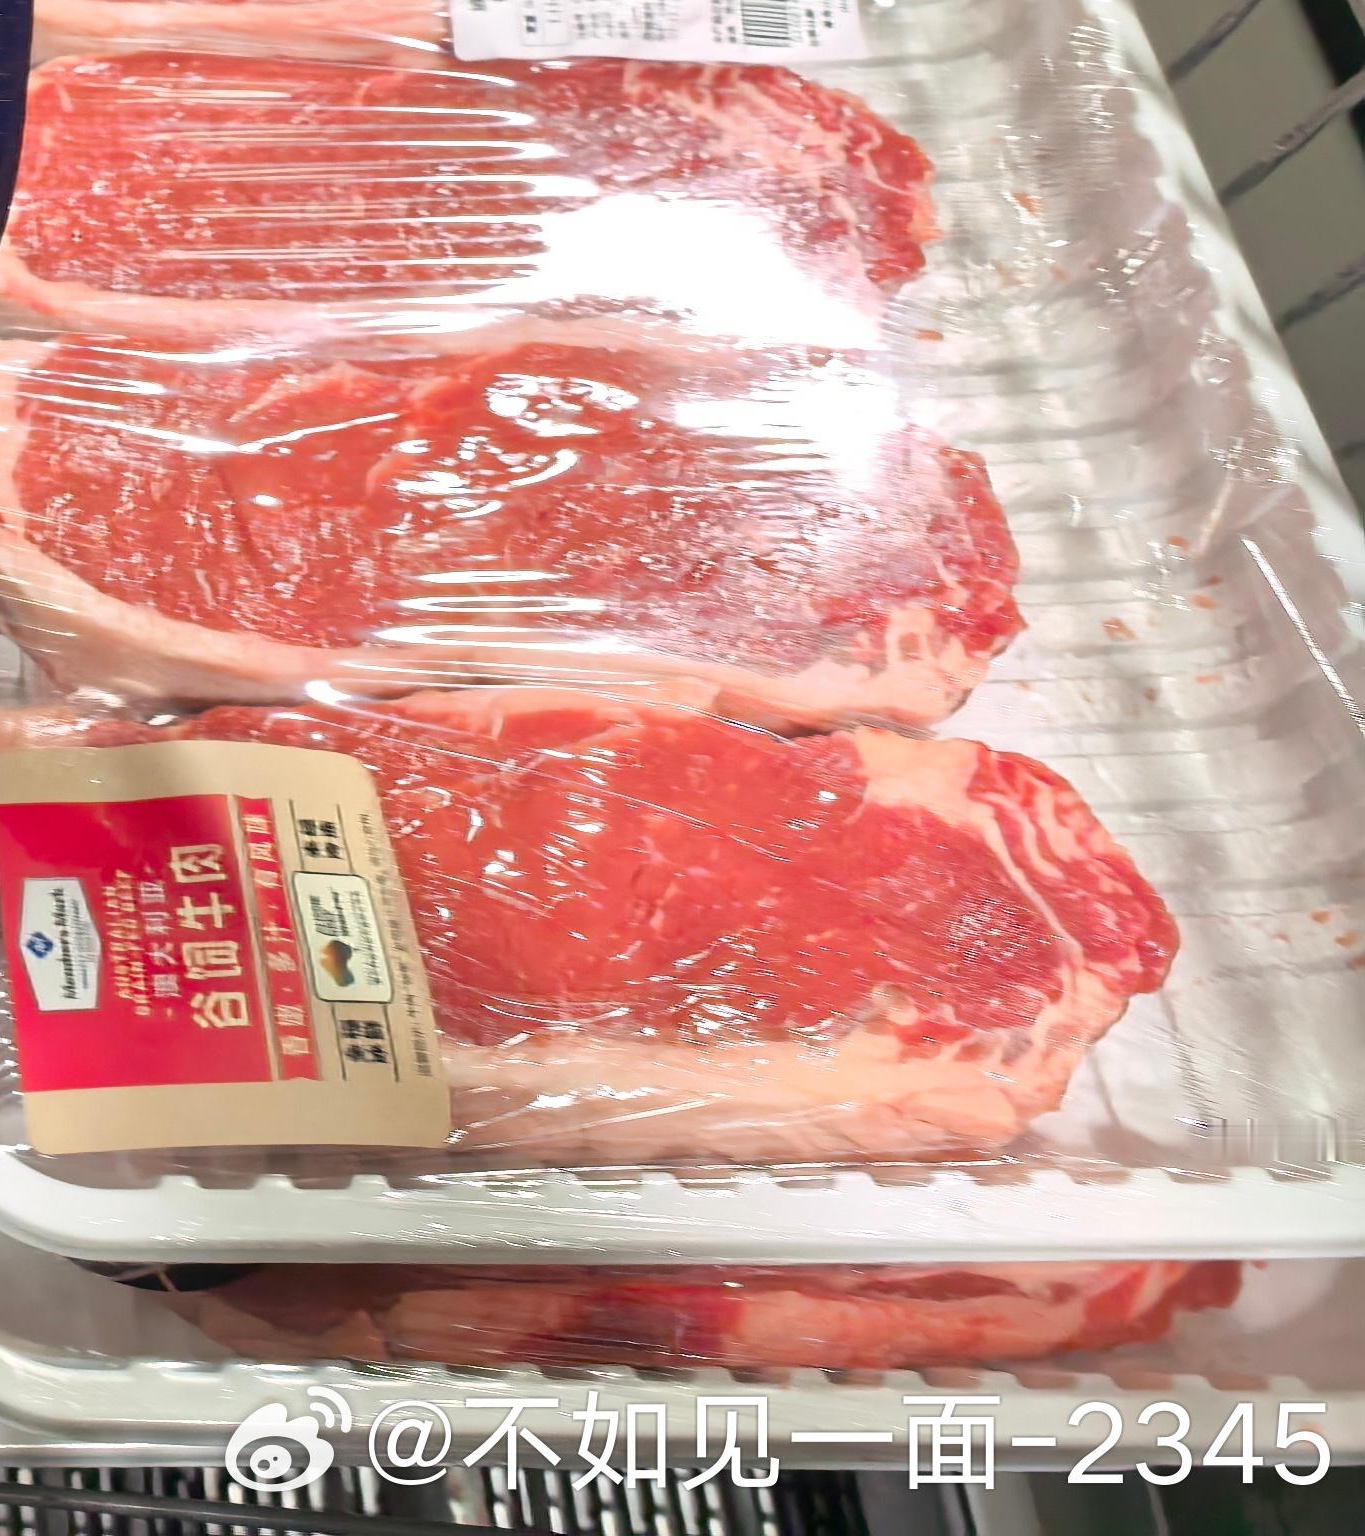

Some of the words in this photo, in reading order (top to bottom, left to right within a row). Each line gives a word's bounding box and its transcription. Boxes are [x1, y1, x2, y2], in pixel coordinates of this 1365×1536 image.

[45, 887, 70, 927] Mark
[169, 843, 252, 1029] 谷饲牛肉
